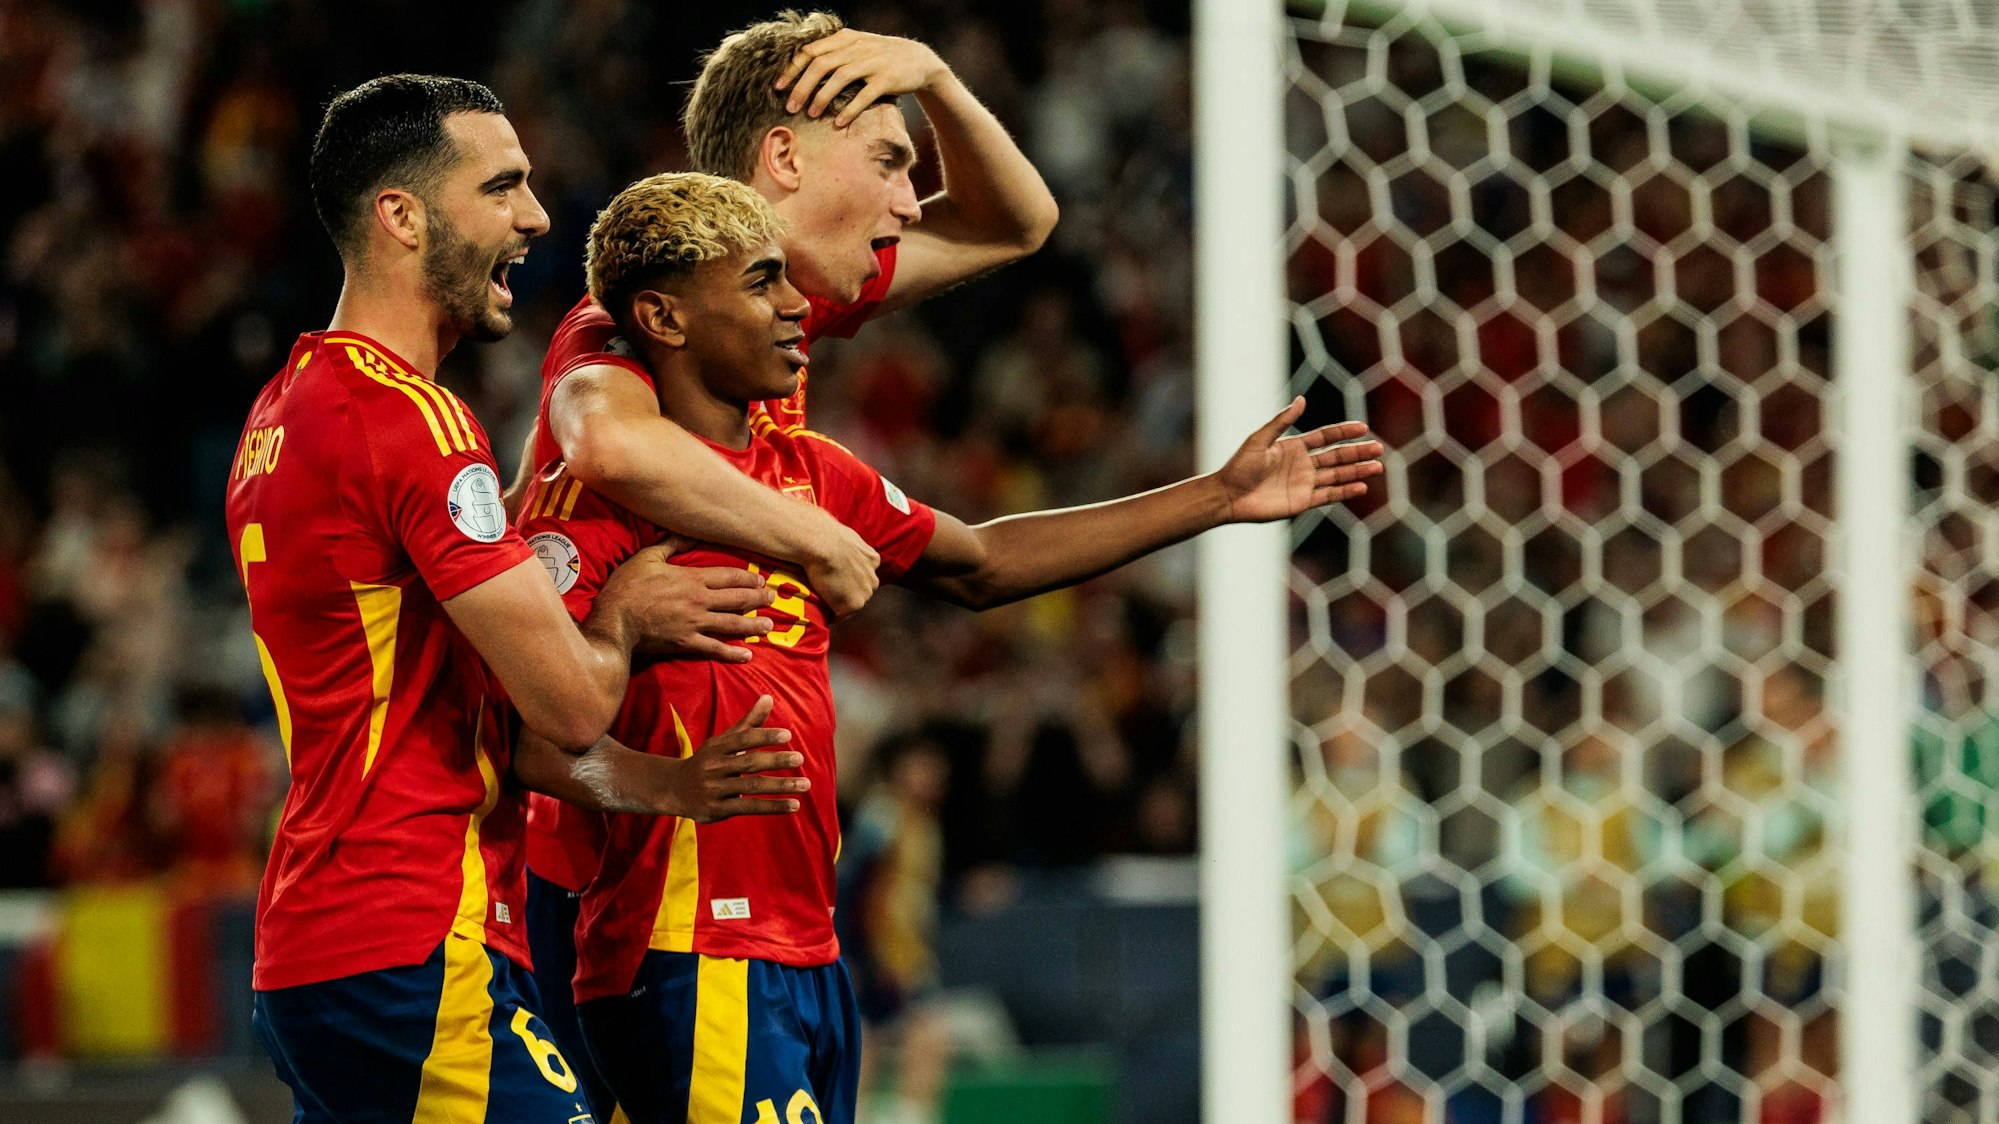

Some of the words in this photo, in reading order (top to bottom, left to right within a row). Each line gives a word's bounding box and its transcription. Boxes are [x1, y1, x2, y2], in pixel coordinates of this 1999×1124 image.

[453, 478, 463, 492] UEFA
[462, 466, 482, 479] NATIONS
[552, 534, 571, 549] LEAGUE
[510, 1007, 578, 1093] 6
